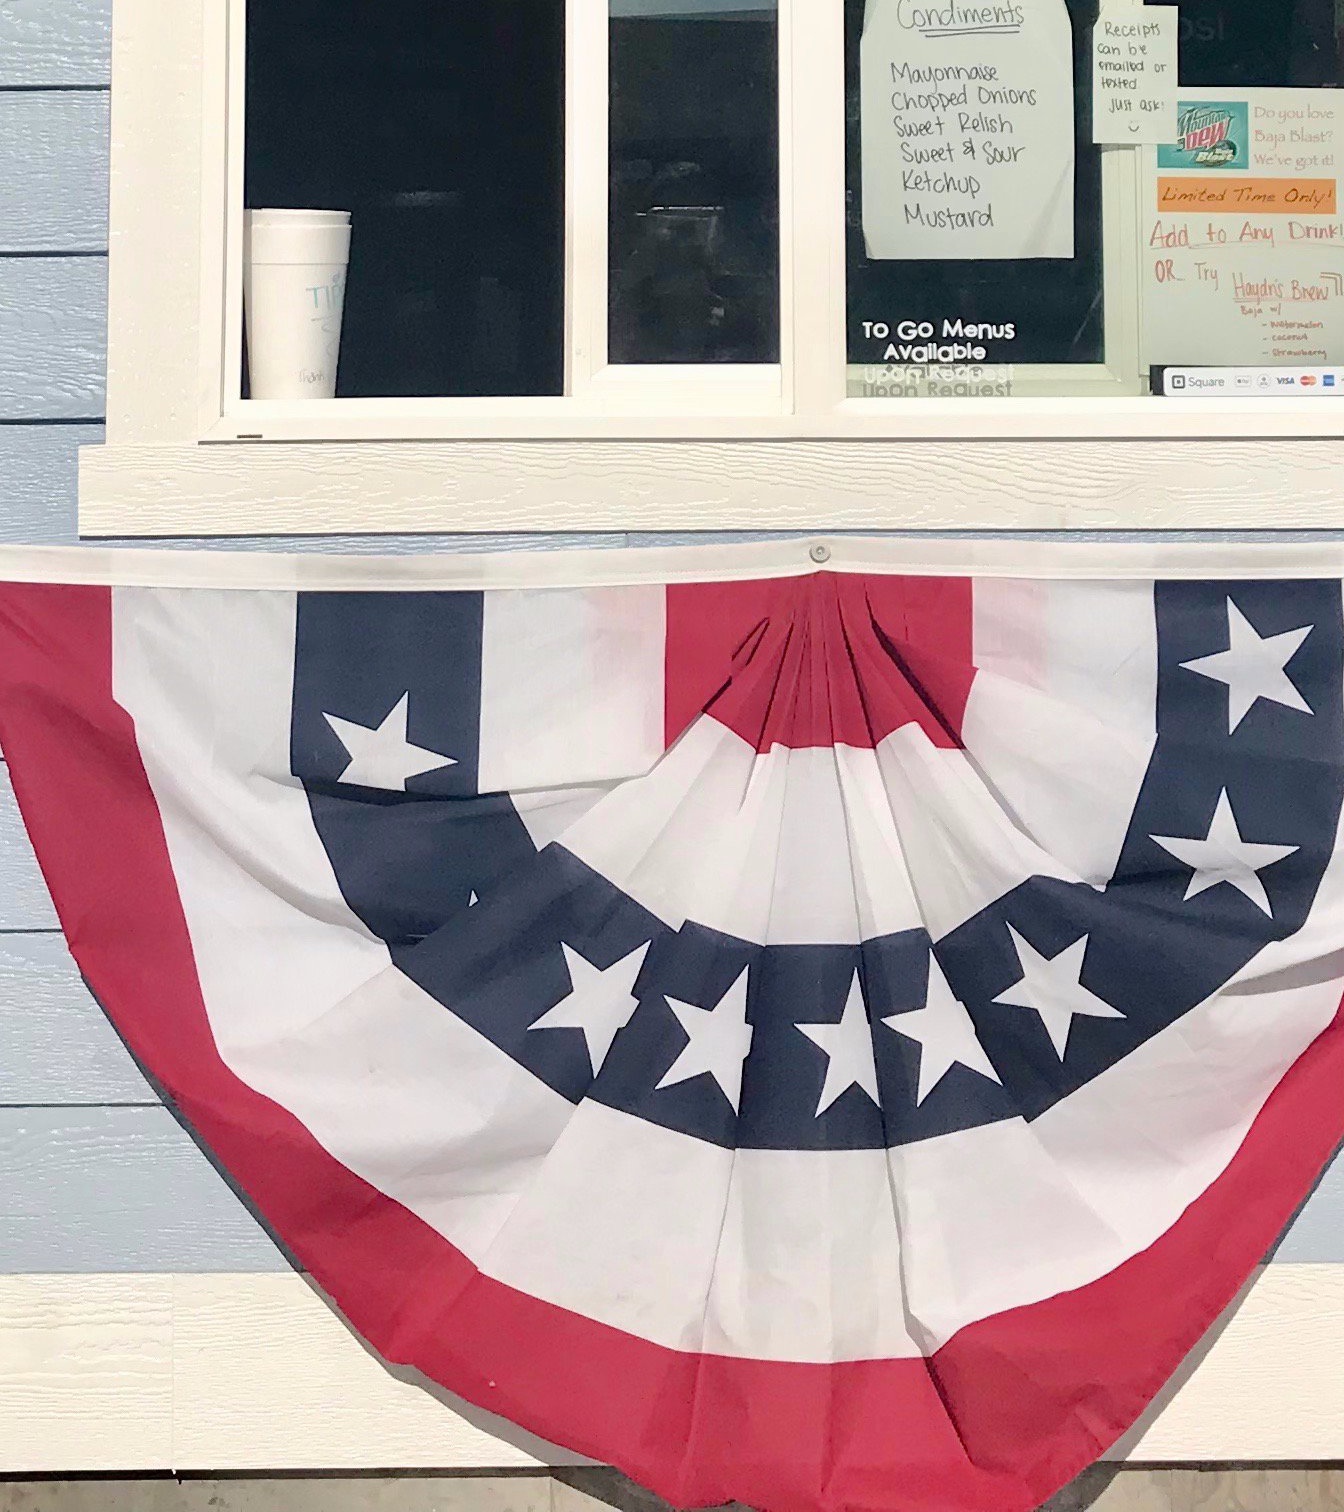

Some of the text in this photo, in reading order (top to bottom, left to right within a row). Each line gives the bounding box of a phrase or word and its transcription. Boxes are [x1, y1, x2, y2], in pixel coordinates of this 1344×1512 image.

[891, 62, 1000, 85] Mayonnaise
[891, 86, 1036, 111] Chopped Onions
[893, 112, 1013, 137] Sweet Relish
[900, 142, 954, 164] Sweet
[903, 169, 981, 195] Ketchup
[1161, 187, 1227, 204] Limited
[1232, 187, 1276, 204] Time
[904, 203, 995, 227] Mustard
[1149, 221, 1190, 247] Add
[1206, 224, 1227, 243] to
[1239, 221, 1274, 246] Any
[862, 319, 1016, 339] To Go Menus
[883, 341, 986, 361] Available
[1188, 377, 1224, 388] Square
